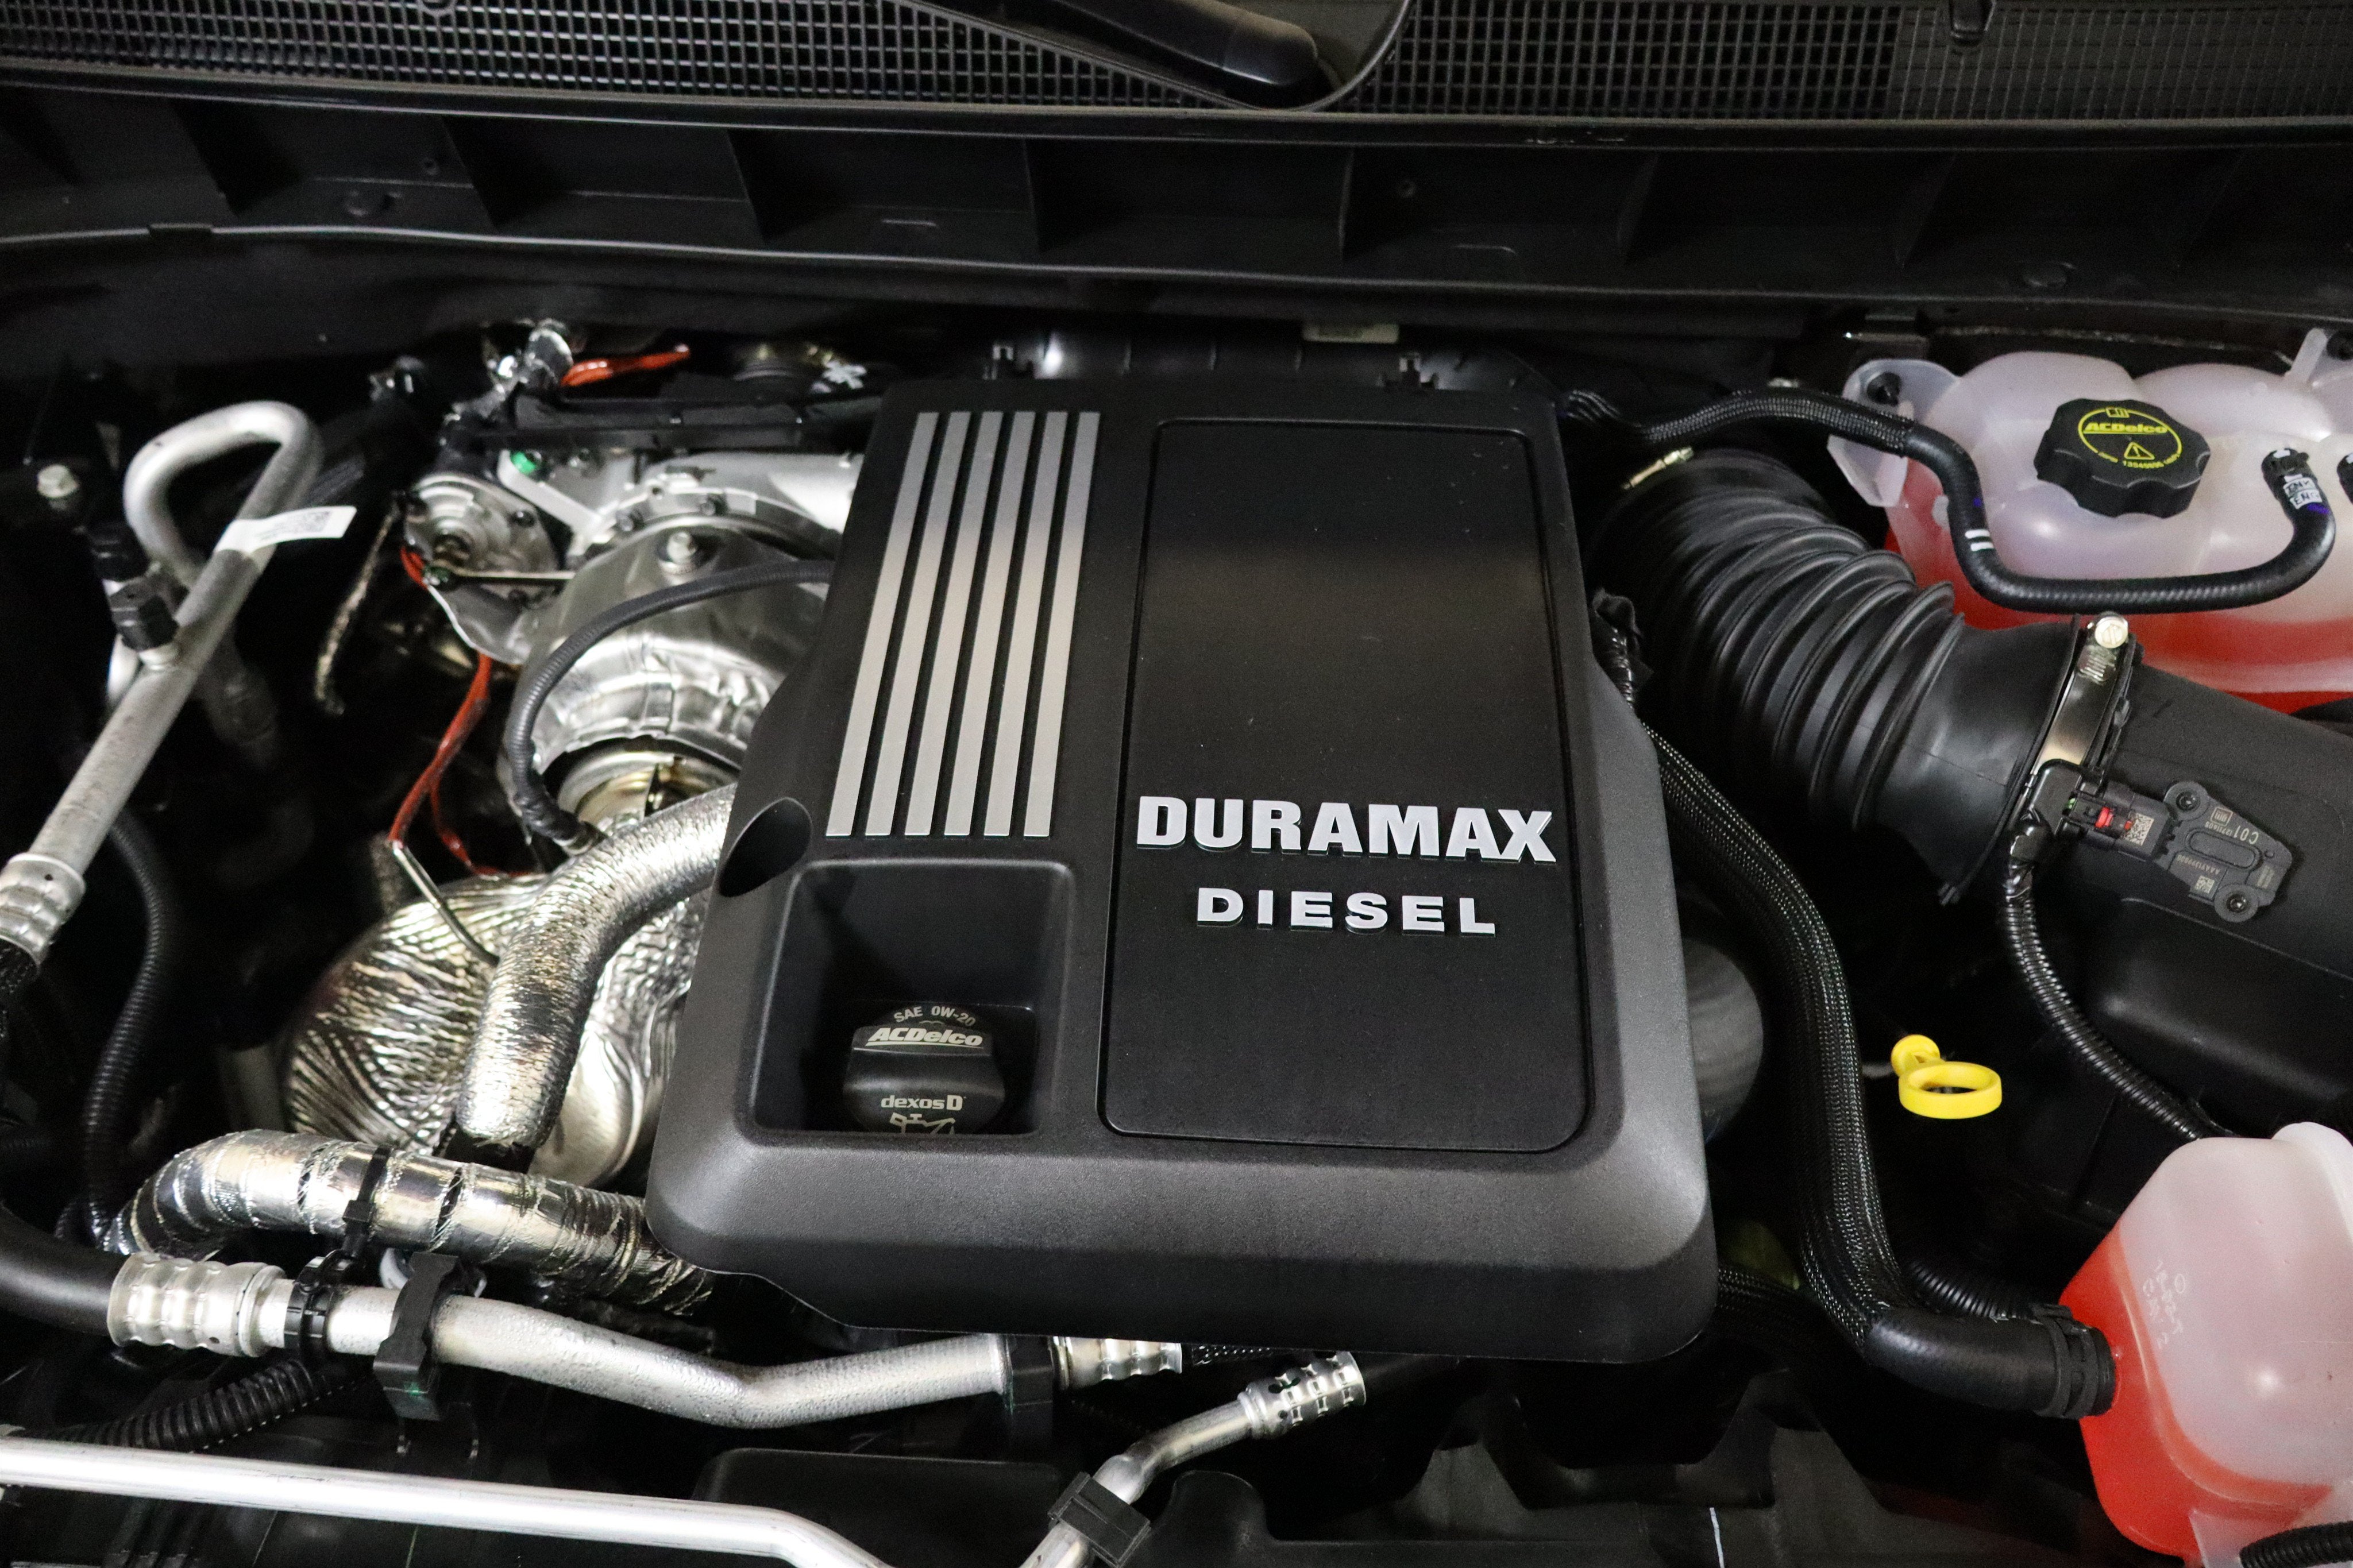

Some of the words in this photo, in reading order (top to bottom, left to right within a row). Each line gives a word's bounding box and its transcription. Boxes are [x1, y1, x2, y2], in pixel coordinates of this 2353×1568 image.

[2084, 422, 2168, 434] ACDelco
[1137, 796, 1556, 863] DURAMAX
[1197, 887, 1495, 937] DIESEL
[893, 1006, 923, 1022] SAE
[931, 1006, 975, 1027] 0W-20
[866, 1028, 983, 1048] ACDelco
